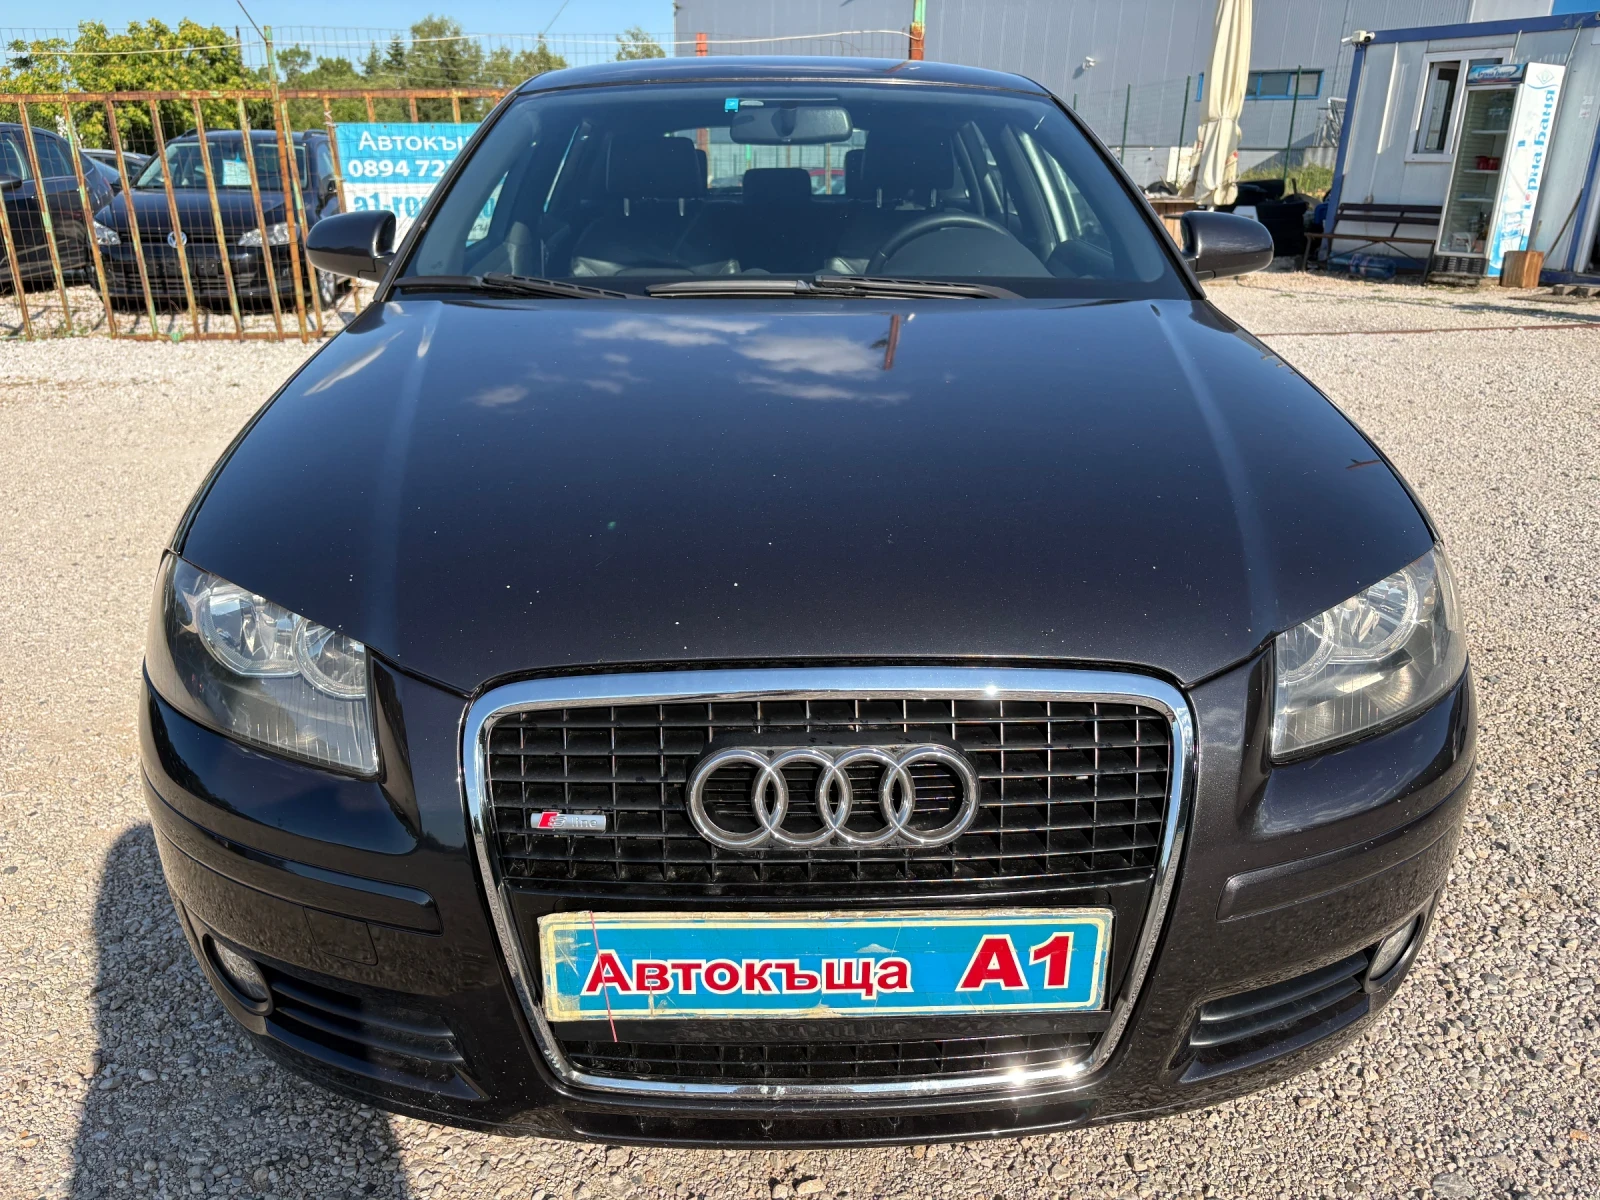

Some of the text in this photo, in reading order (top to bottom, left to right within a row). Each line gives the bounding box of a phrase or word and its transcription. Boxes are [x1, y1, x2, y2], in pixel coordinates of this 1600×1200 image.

[347, 159, 454, 178] 0894 72
[571, 816, 598, 829] line
[583, 951, 911, 1000] Автокъща
